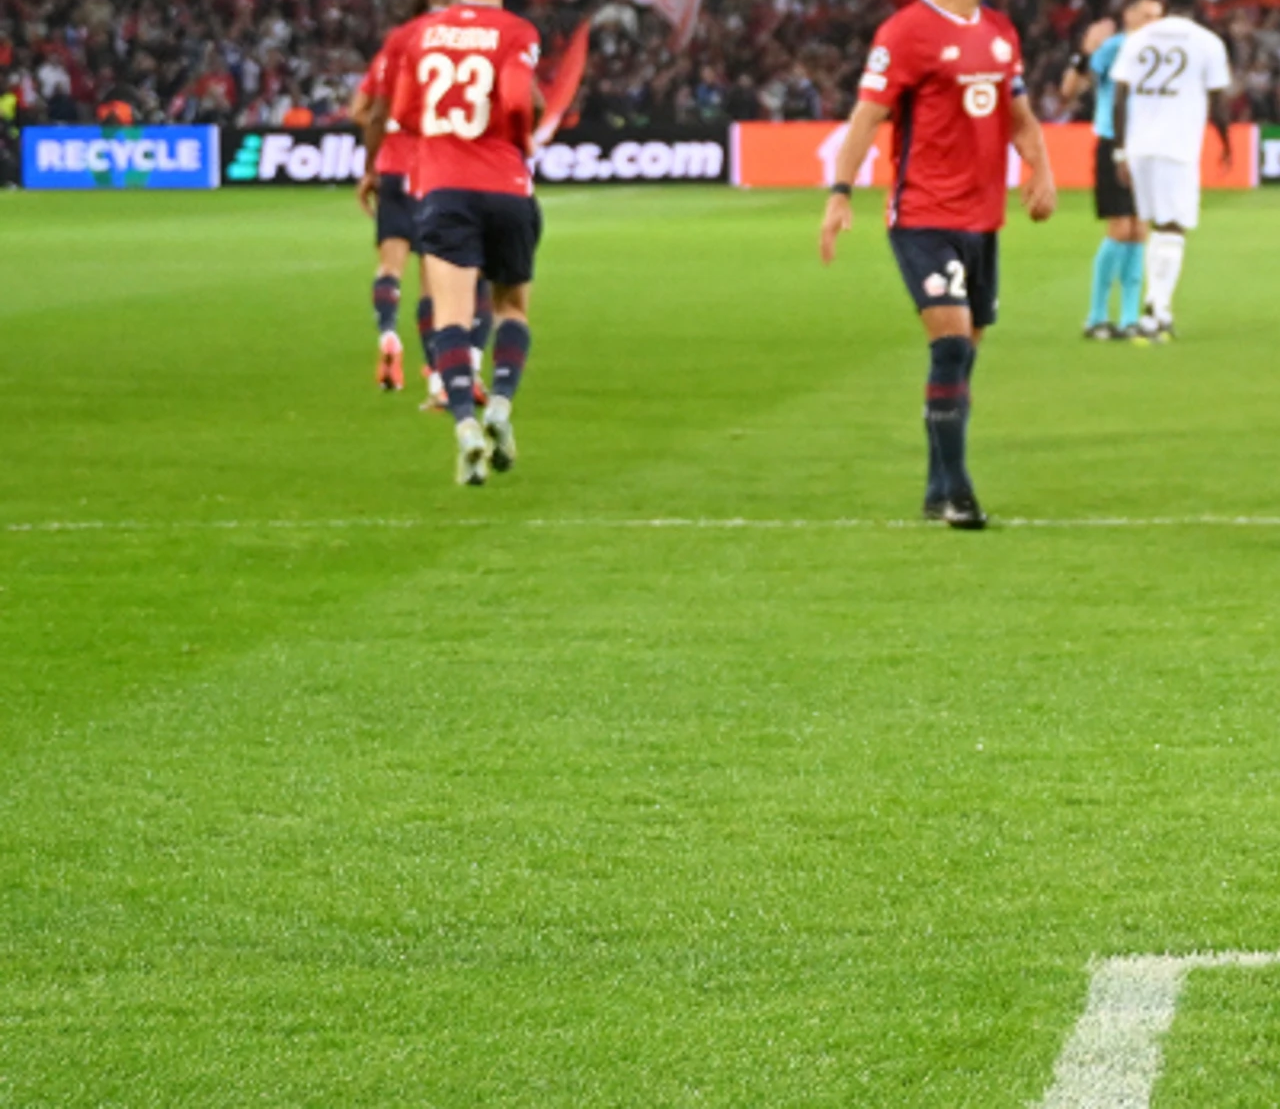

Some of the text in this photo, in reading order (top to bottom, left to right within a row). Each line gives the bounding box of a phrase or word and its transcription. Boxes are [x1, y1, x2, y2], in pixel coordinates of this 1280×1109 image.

[1136, 45, 1189, 96] 22
[417, 52, 495, 140] 23
[36, 139, 202, 172] RECYCLE
[946, 259, 968, 298] 2
